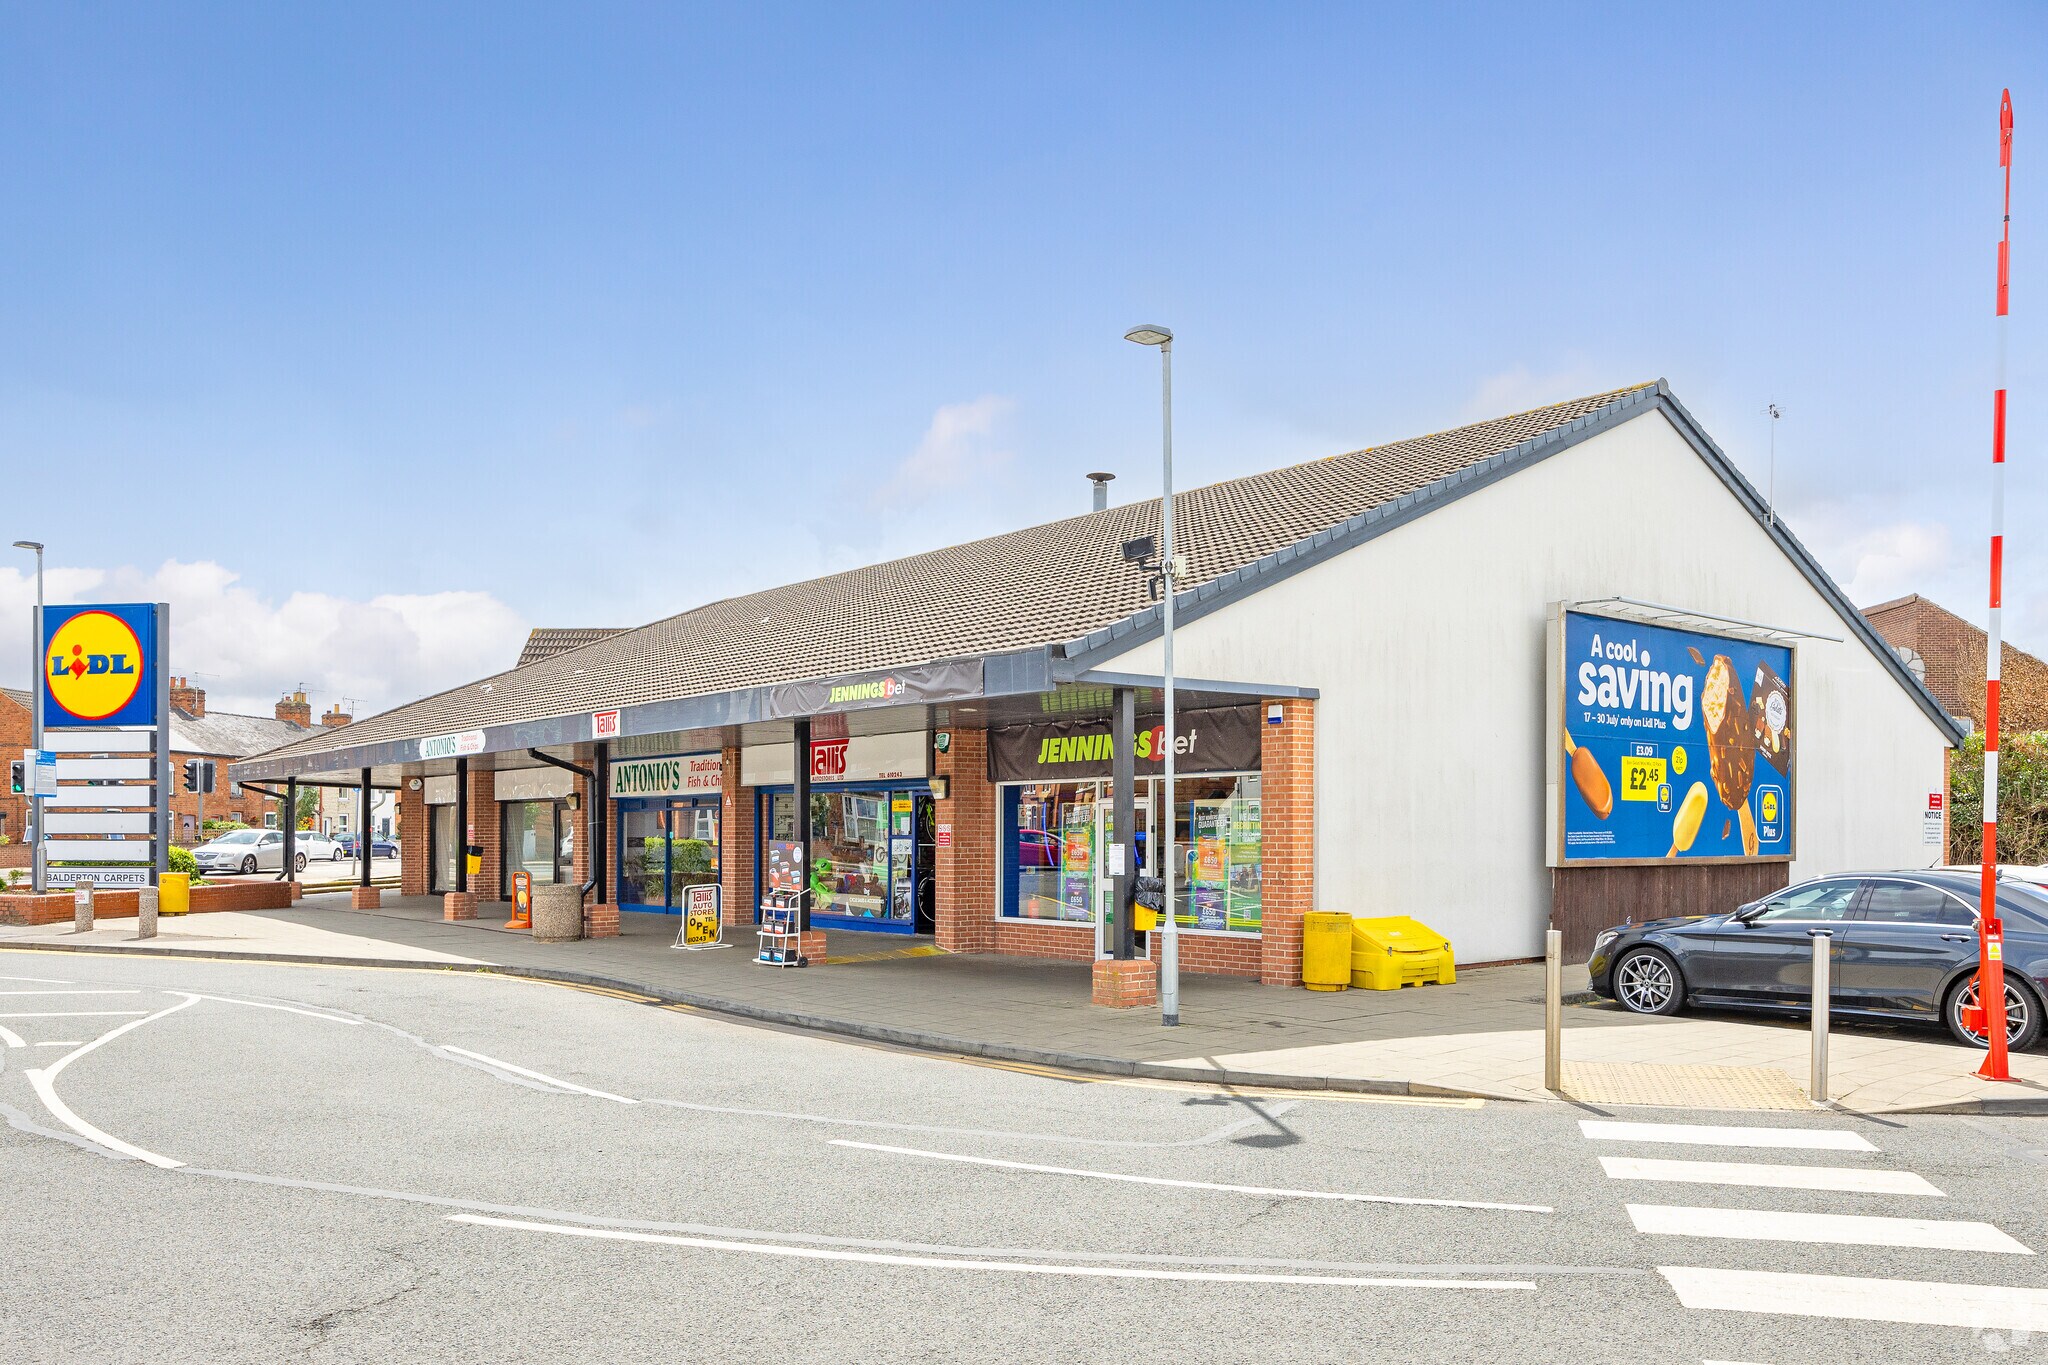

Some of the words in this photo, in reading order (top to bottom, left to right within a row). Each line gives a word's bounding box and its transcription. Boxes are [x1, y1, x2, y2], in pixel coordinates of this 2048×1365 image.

[1590, 633, 1603, 658] A
[1605, 639, 1638, 663] cool
[1577, 650, 1693, 731] saving
[594, 711, 618, 734] Tallis
[1583, 711, 1591, 723] 17
[1597, 713, 1606, 724] 30
[1620, 715, 1633, 729] only
[1633, 719, 1642, 727] on
[1642, 717, 1653, 728] Lidl
[1653, 718, 1667, 729] Plus
[425, 735, 456, 757] ANTONIO'S
[1635, 745, 1653, 757] £3.09
[615, 760, 680, 793] ANTONIO'S
[687, 776, 700, 788] Fish
[703, 775, 709, 787] &
[1924, 811, 1942, 820] NOTICE
[1763, 825, 1776, 837] Plus
[46, 873, 100, 883] BALDERTON
[103, 873, 146, 883] CARPETS
[691, 889, 713, 903] Tallis
[690, 909, 715, 917] STORES
[692, 902, 713, 910] AUTO
[690, 917, 715, 938] OPEN
